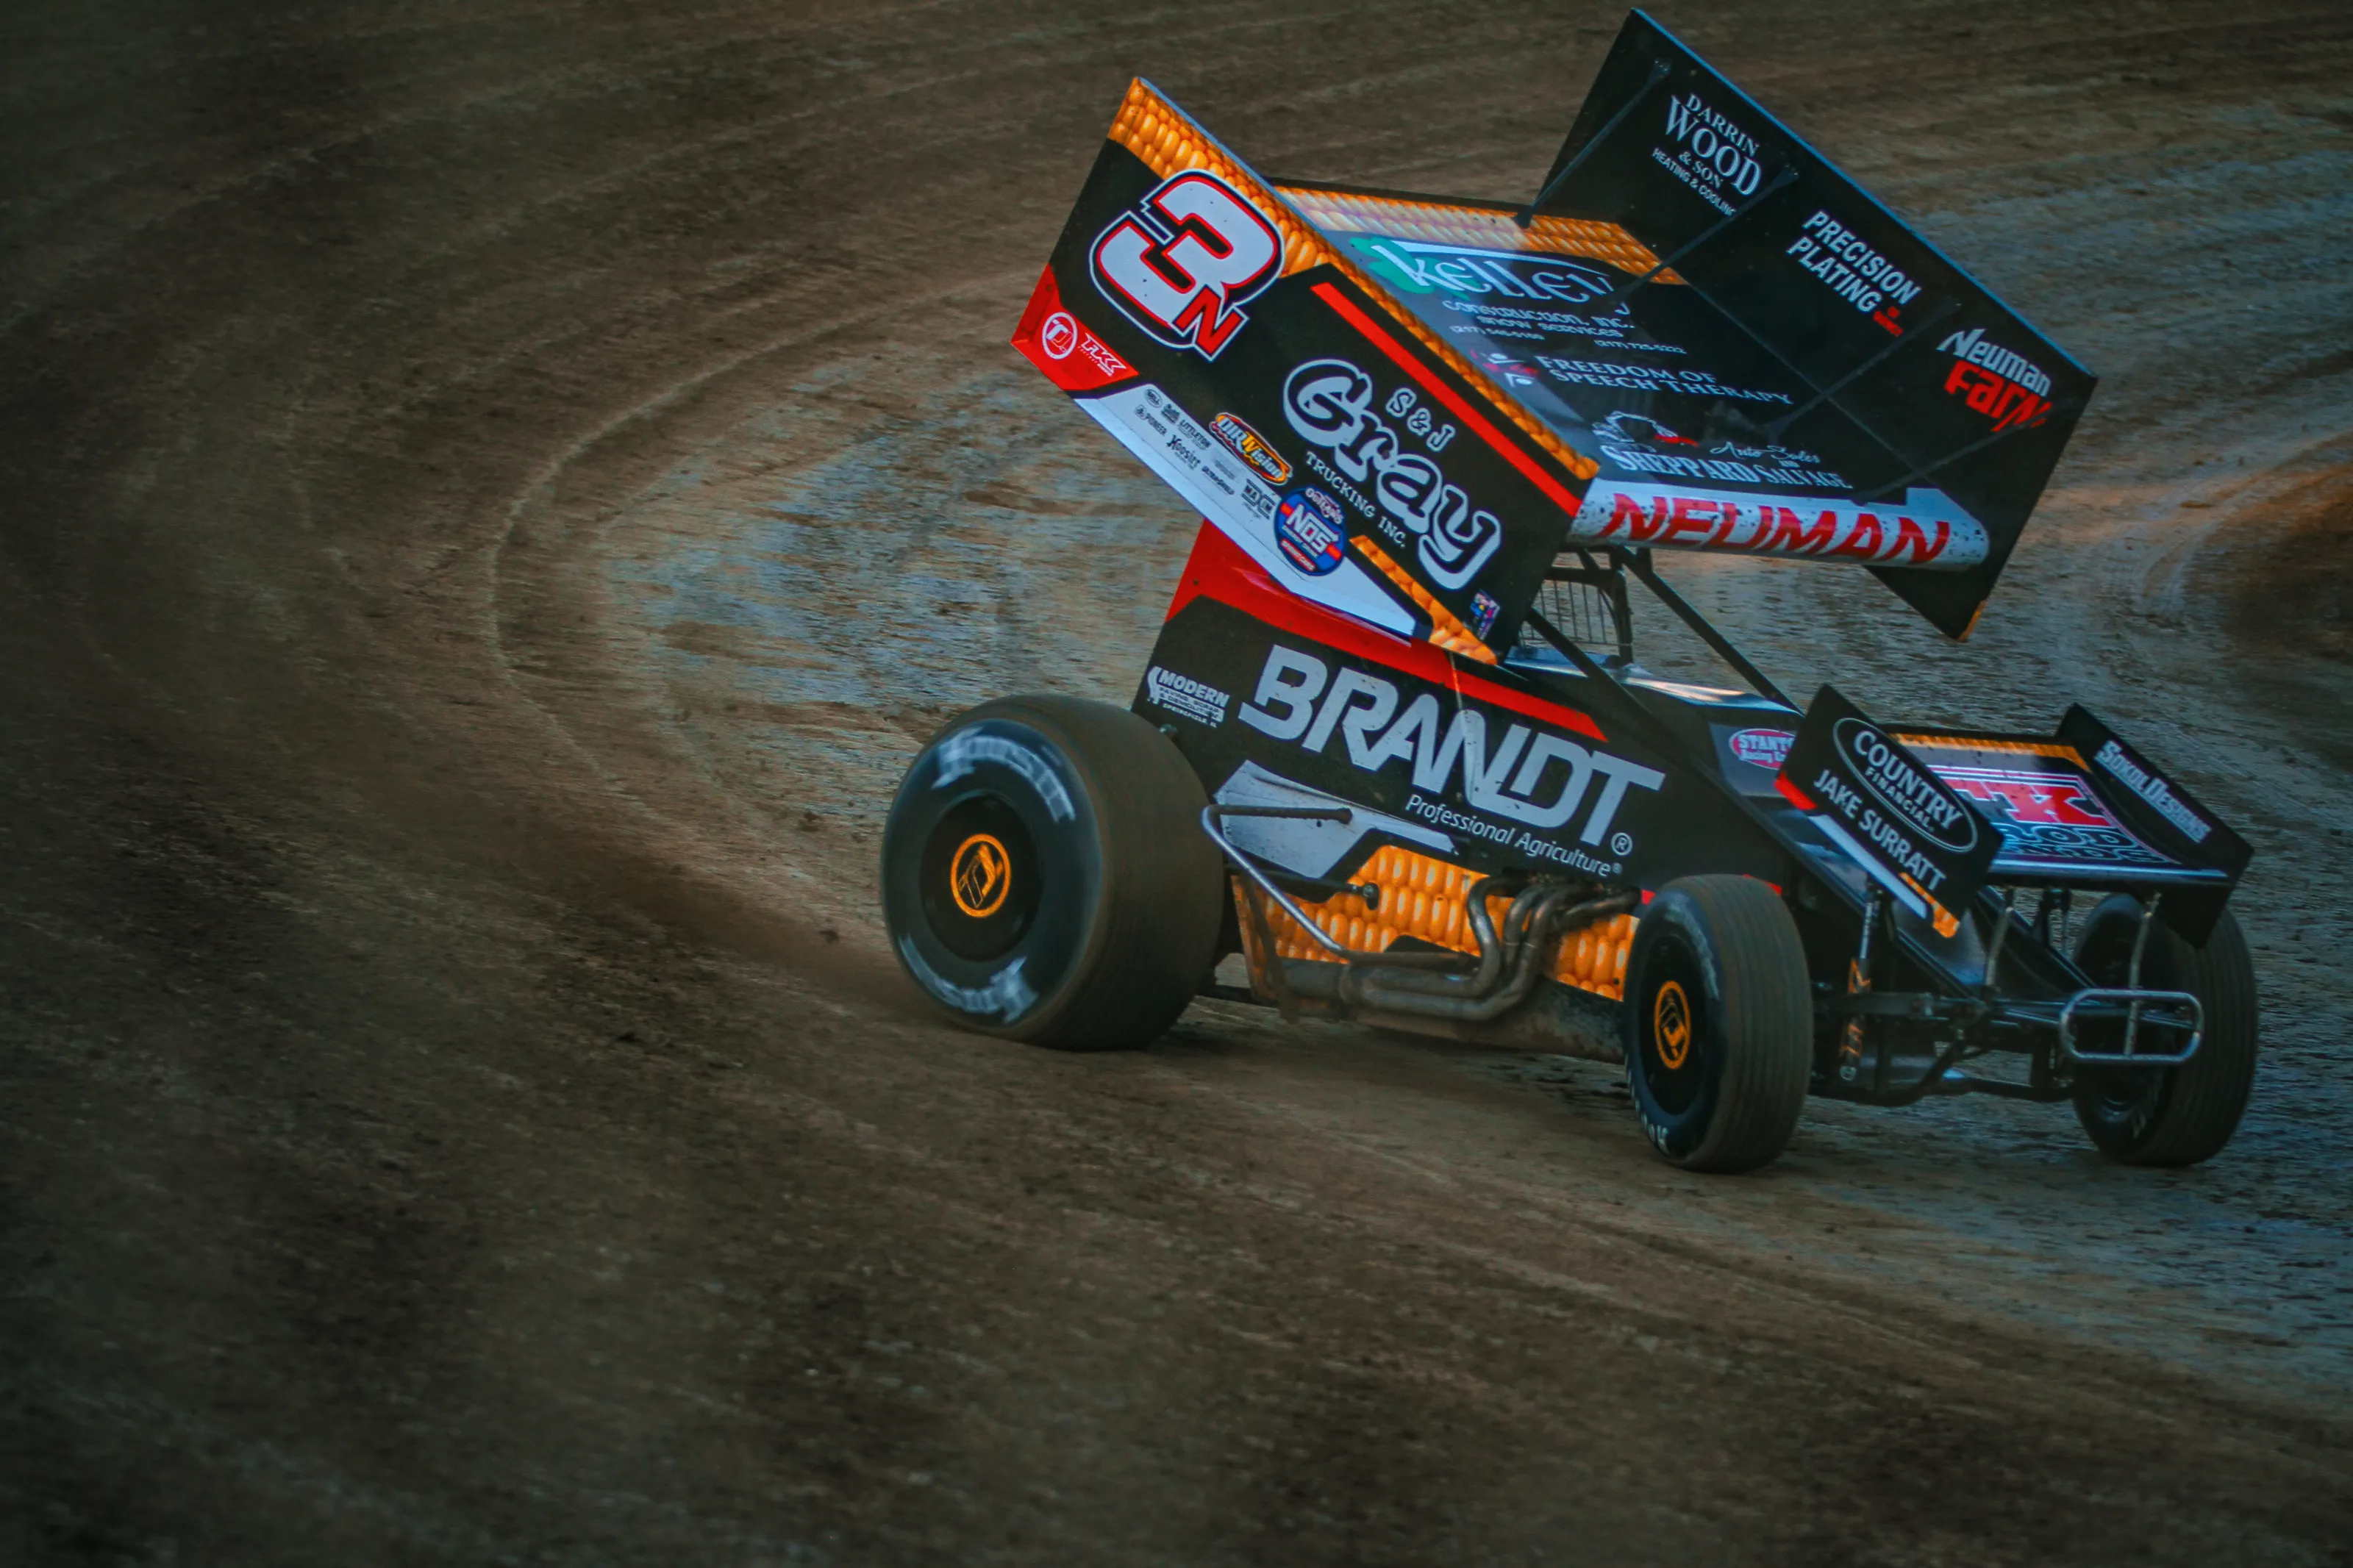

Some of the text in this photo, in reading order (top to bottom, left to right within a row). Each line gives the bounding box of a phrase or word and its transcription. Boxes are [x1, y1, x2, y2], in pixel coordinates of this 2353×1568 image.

[1665, 94, 1763, 196] WOOD
[1686, 93, 1760, 157] DARRIN
[1652, 148, 1692, 183] HEATING
[1689, 178, 1699, 190] &
[1678, 151, 1724, 189] & SON
[1785, 236, 1883, 313] PLATING
[1801, 210, 1922, 306] PRECISION
[1533, 354, 1718, 384] FREEDOM OF
[1549, 368, 1795, 405] SPEECH THERAPY
[1935, 328, 2052, 398] Neuman
[1282, 358, 1502, 591] Gray
[1305, 450, 1407, 549] TRUCKING INC.
[1599, 444, 1854, 489] SHEPPARD SALVAGE
[1285, 503, 1339, 556] NOS
[1596, 493, 1951, 564] NEUMAN
[1158, 669, 1230, 708] MODERN
[1854, 730, 1964, 831] COUNTRY
[1404, 793, 1516, 845] Professional
[1813, 769, 1947, 892] JAKE SURRATT
